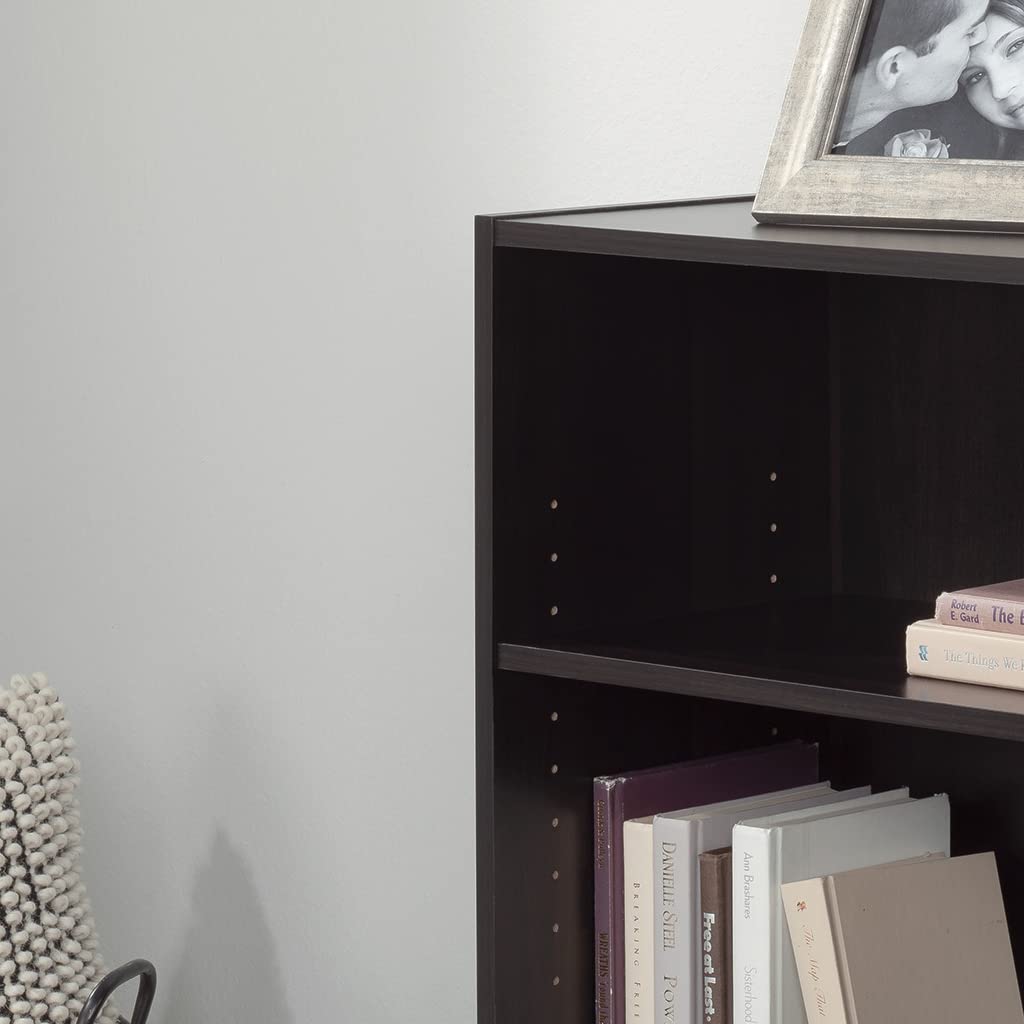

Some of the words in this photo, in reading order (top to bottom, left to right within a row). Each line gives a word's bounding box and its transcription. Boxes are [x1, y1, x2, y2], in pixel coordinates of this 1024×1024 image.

[951, 599, 977, 612] Robert
[951, 610, 959, 621] E.
[960, 612, 981, 625] Gard
[991, 605, 1015, 625] The
[943, 648, 963, 664] The
[965, 651, 999, 670] Things
[1002, 656, 1018, 670] We
[662, 841, 678, 906] DANIELLE
[743, 851, 755, 872] Ann
[743, 874, 756, 920] Brashares
[633, 882, 641, 967] BREAKING
[662, 910, 679, 952] STEEL
[703, 912, 716, 952] Free
[803, 925, 816, 949] The
[599, 932, 609, 978] WREATHS
[704, 954, 715, 974] at
[807, 953, 821, 983] Map
[633, 982, 641, 1017] FREE
[704, 977, 717, 1015] Last
[815, 988, 826, 1017] That
[599, 1011, 609, 1024] the
